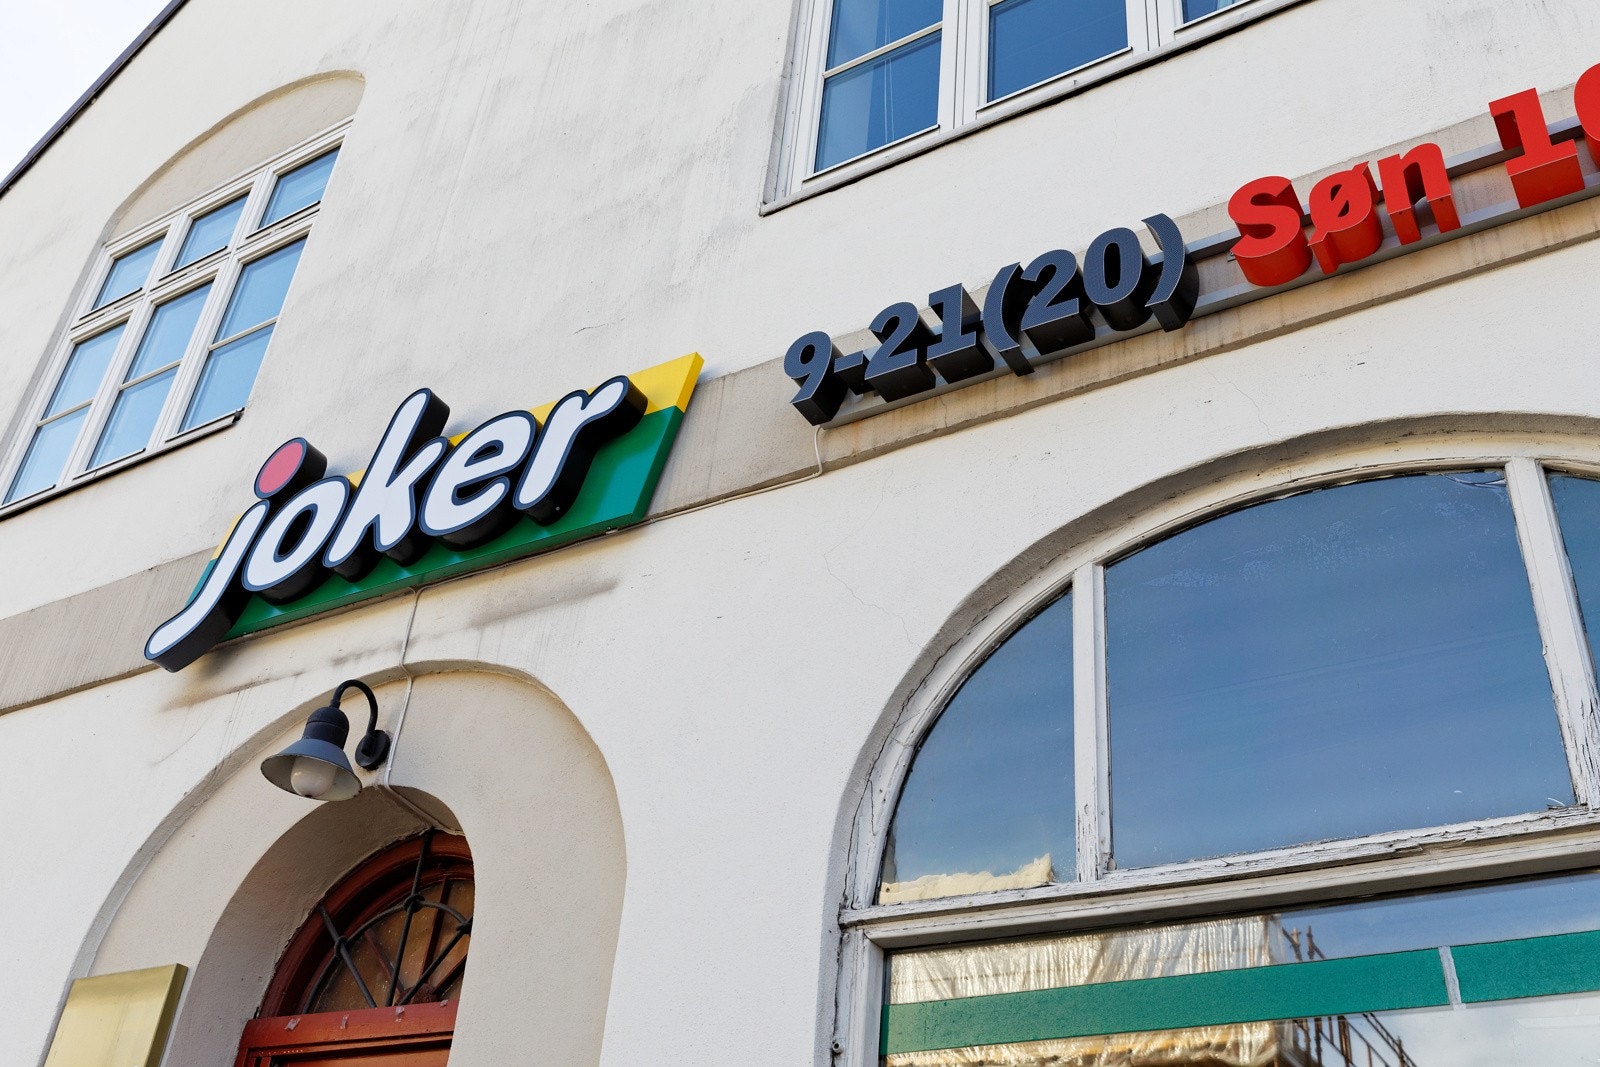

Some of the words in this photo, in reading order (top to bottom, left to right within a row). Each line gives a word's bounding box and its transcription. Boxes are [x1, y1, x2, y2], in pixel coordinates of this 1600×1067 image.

[783, 213, 1189, 403] 9-21(20)
[1227, 142, 1453, 262] Søn
[144, 374, 630, 662] joker
